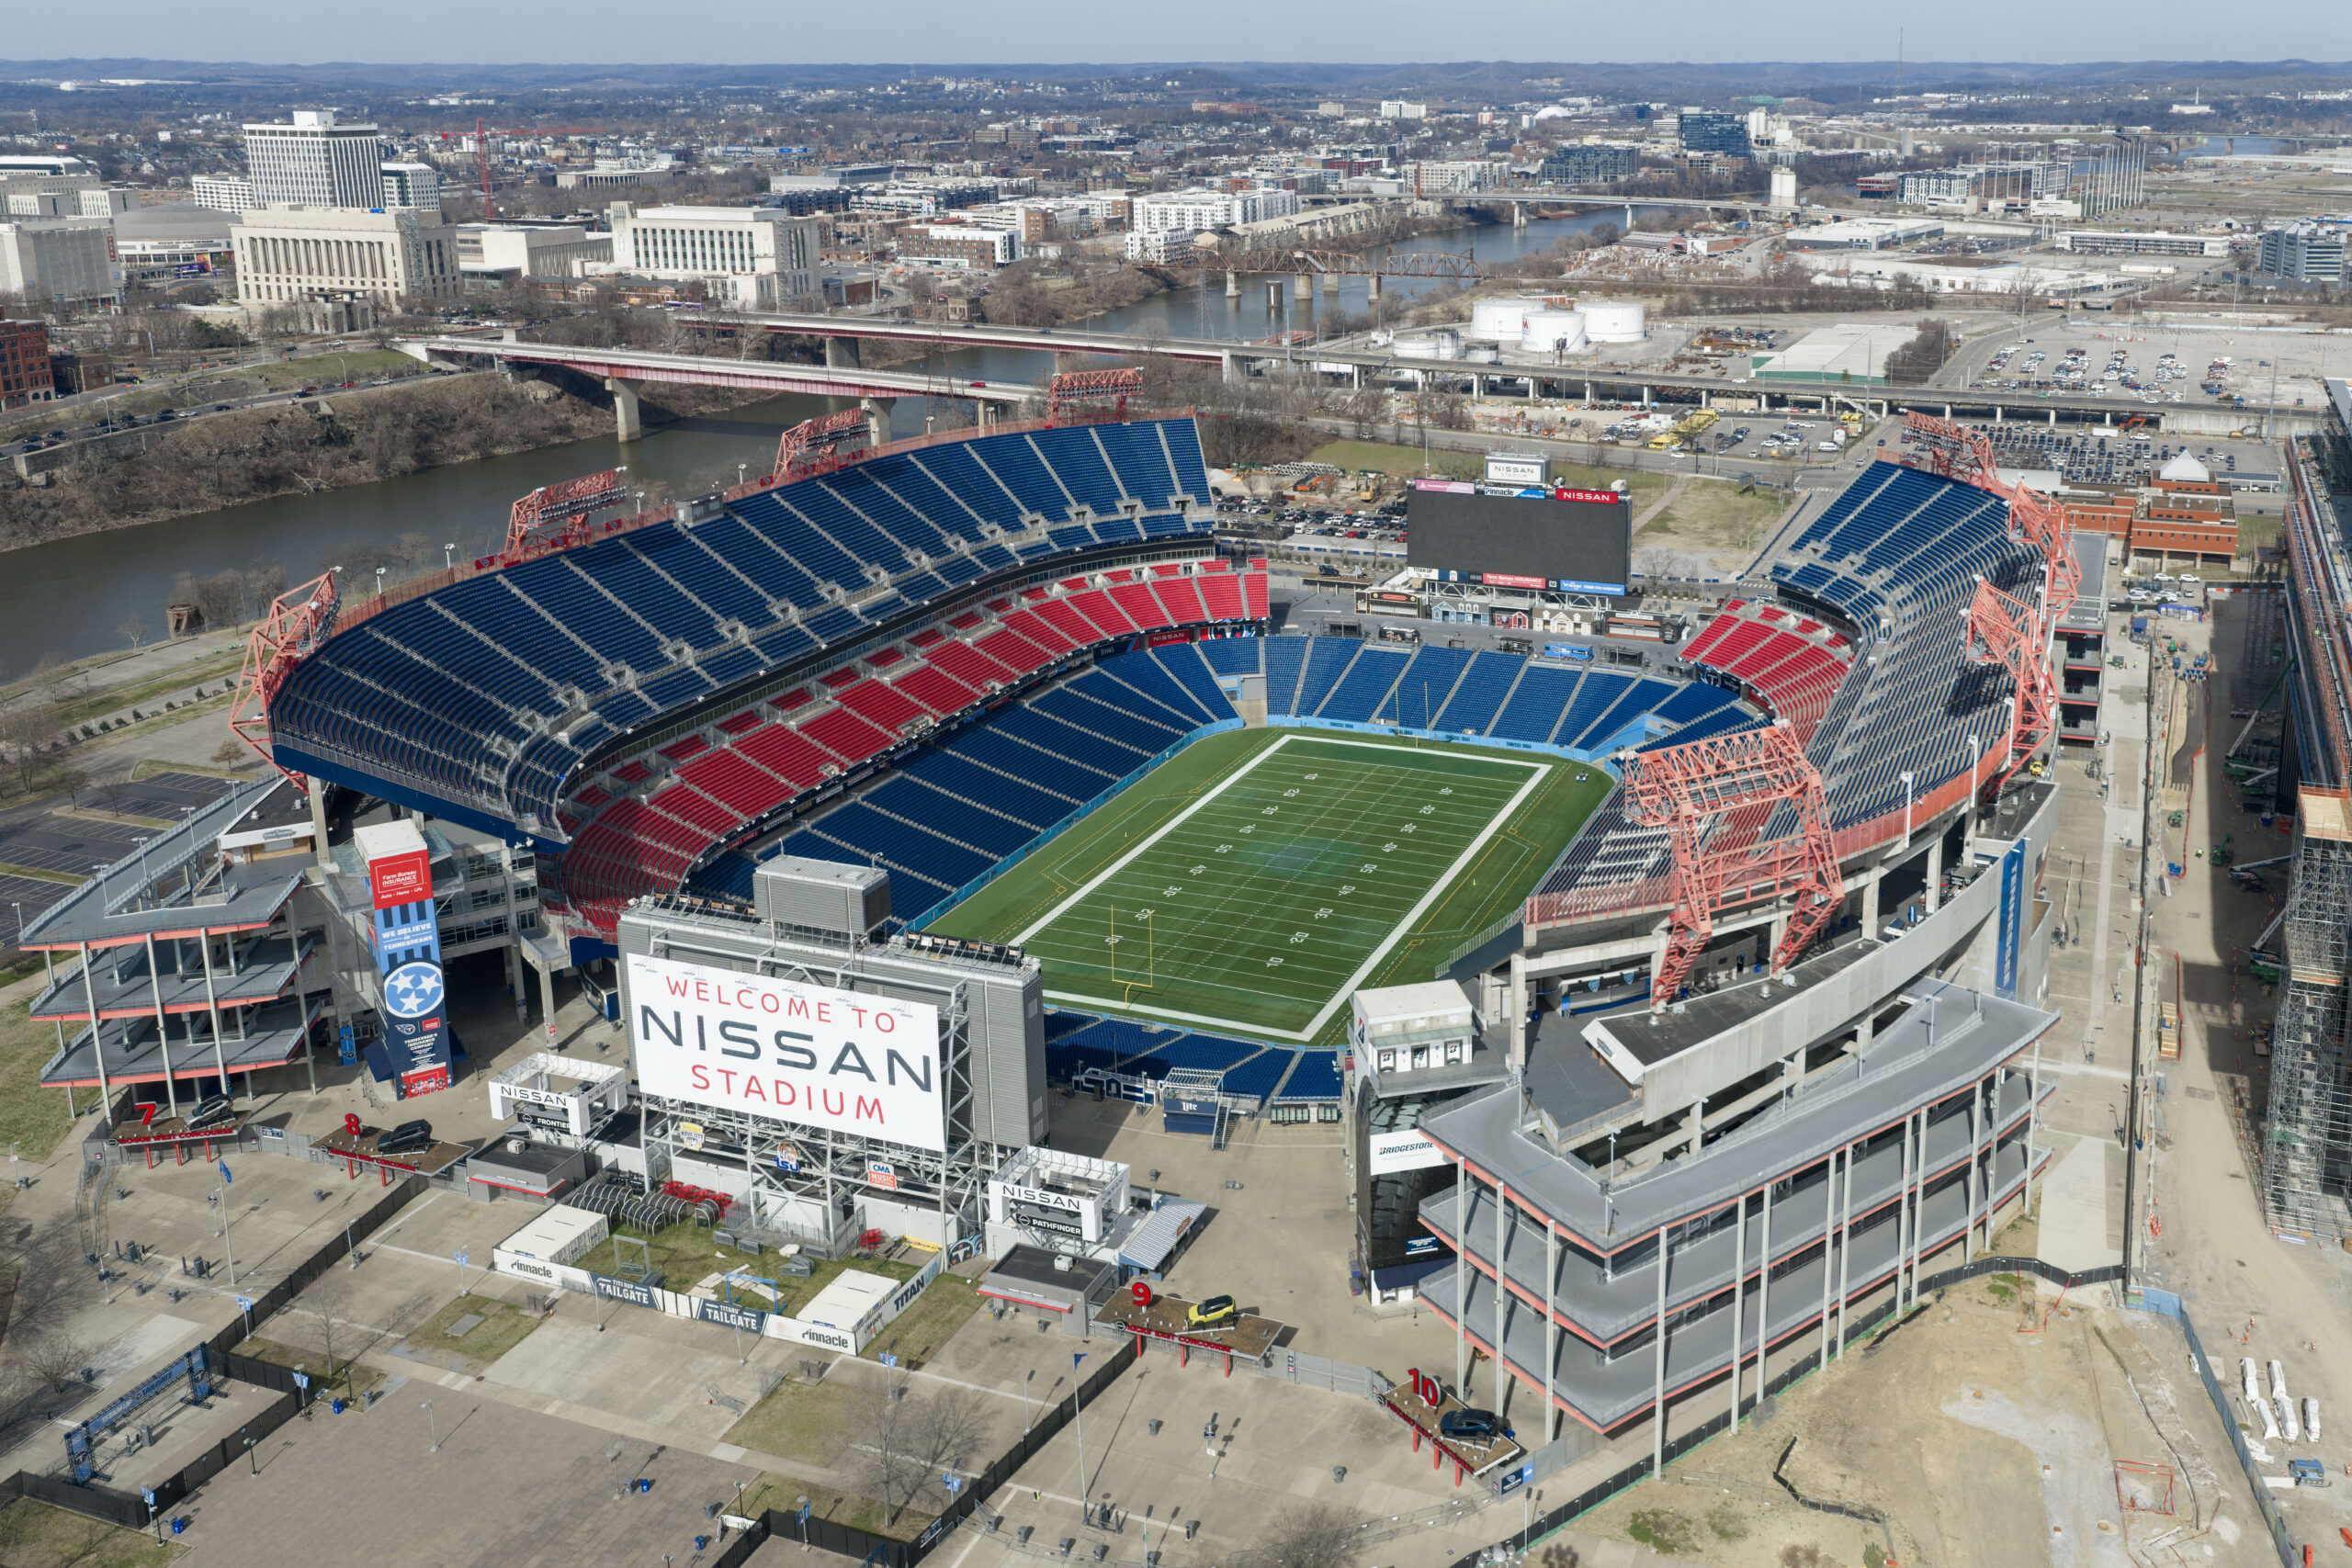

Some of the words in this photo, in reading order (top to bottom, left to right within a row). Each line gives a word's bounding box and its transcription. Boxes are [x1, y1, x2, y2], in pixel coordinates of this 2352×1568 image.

[1495, 466, 1534, 474] NISSAN
[1485, 487, 1514, 496] Pinnacle
[1564, 491, 1610, 502] NISSAN
[1154, 633, 1184, 641] NISSAN
[1215, 844, 1233, 852] 50
[1360, 863, 1377, 874] 50
[382, 874, 417, 886] INSURANCE
[1315, 908, 1332, 919] 30
[382, 930, 395, 939] WE
[397, 922, 432, 935] BELIEVE
[1290, 931, 1309, 944] 20
[384, 935, 434, 950] TENNESSEANS
[665, 976, 831, 1023] WELCOME
[852, 1008, 895, 1032] TO
[408, 1038, 435, 1047] INSURANCE
[410, 1043, 434, 1051] COMPANY
[640, 1004, 932, 1093] NISSAN
[501, 1086, 566, 1106] NISSAN
[588, 1079, 616, 1100] NISSAN
[691, 1064, 885, 1124] STADIUM
[135, 1101, 156, 1124] 7
[1182, 1102, 1198, 1111] Lite
[345, 1112, 360, 1135] 8
[537, 1117, 571, 1128] FRONTIER
[119, 1135, 151, 1145] ROGUE
[178, 1128, 233, 1139] CONCOURSE
[1379, 1141, 1433, 1156] BRIDGESTONE
[329, 1148, 356, 1159] ARMADA
[356, 1154, 375, 1163] WEST
[375, 1157, 415, 1172] CONCOURSE
[873, 1165, 891, 1174] CMA
[871, 1172, 894, 1185] MUSIC
[1002, 1185, 1080, 1210] NISSAN
[1033, 1219, 1080, 1235] PATHFINDER
[511, 1260, 552, 1279] Pinnacle
[599, 1282, 649, 1304] TAILGATE
[1132, 1281, 1151, 1306] 9
[706, 1307, 757, 1330] TAILGATE
[802, 1330, 849, 1348] Pinnacle
[1126, 1325, 1152, 1336] KICKS
[1154, 1330, 1177, 1341] EAST
[1178, 1336, 1233, 1352] CONCOURSE
[142, 1372, 174, 1396] TAILGATE
[1408, 1368, 1437, 1406] 10
[1387, 1400, 1415, 1427] MURANO
[1415, 1424, 1431, 1440] EAST
[1431, 1438, 1475, 1475] CONCOURSE
